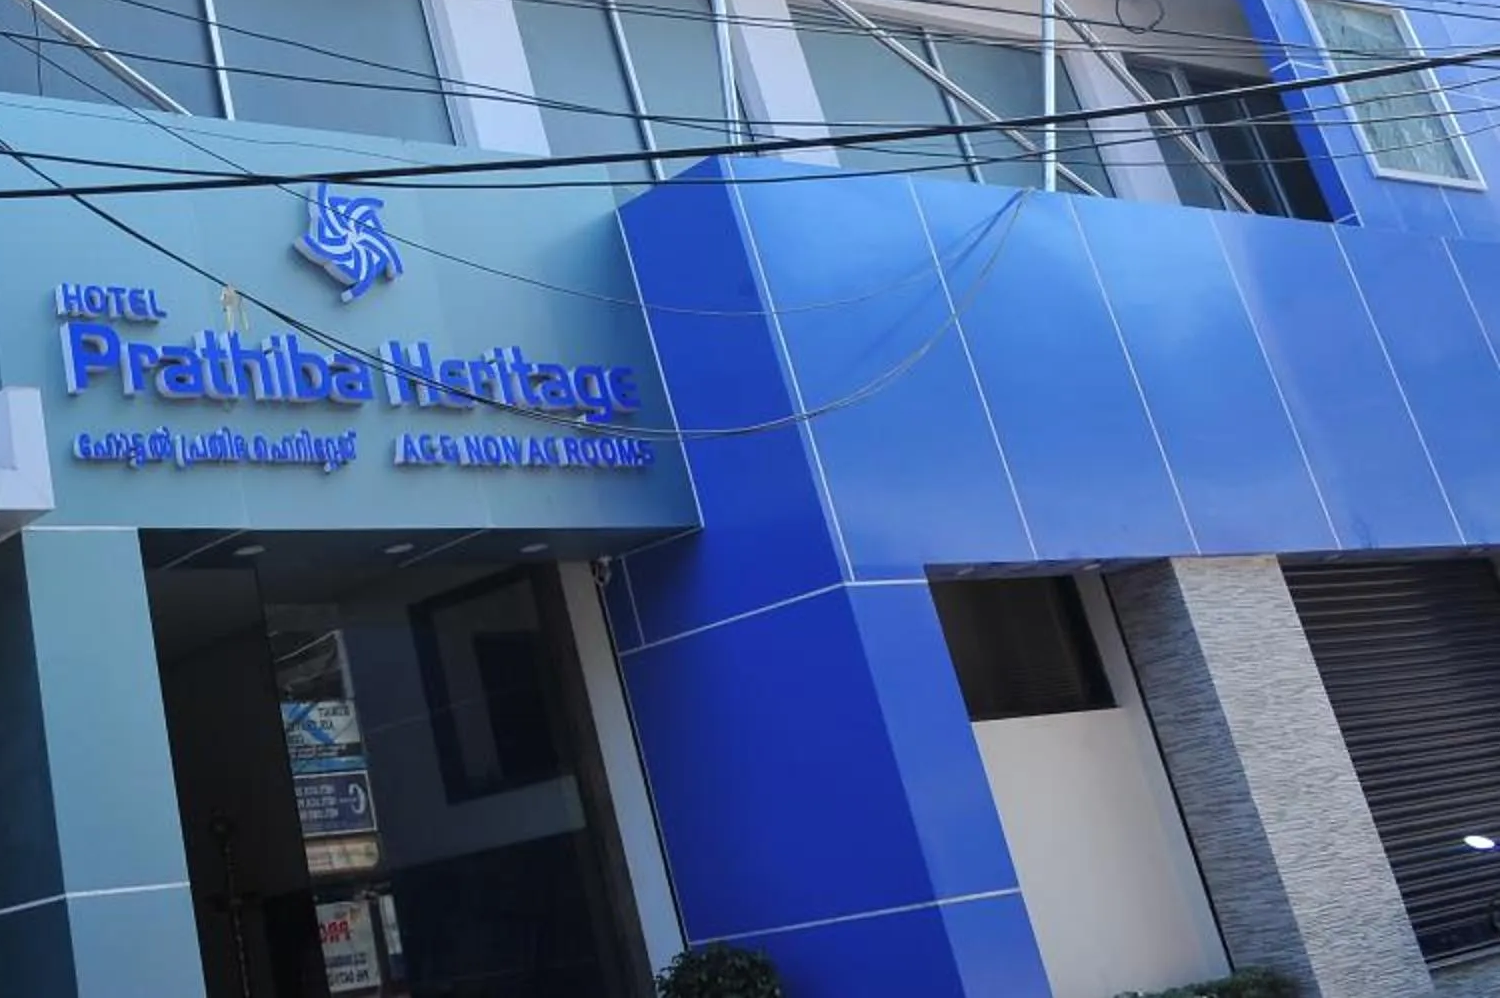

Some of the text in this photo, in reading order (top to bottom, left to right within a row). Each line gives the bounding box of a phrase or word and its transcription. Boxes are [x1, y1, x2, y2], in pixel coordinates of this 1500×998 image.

[56, 283, 167, 322] HOTEL
[60, 321, 642, 423] Prathiba Heritage
[395, 434, 436, 464] AC
[457, 435, 522, 466] NON
[522, 436, 560, 465] AC
[559, 437, 656, 467] ROOMS
